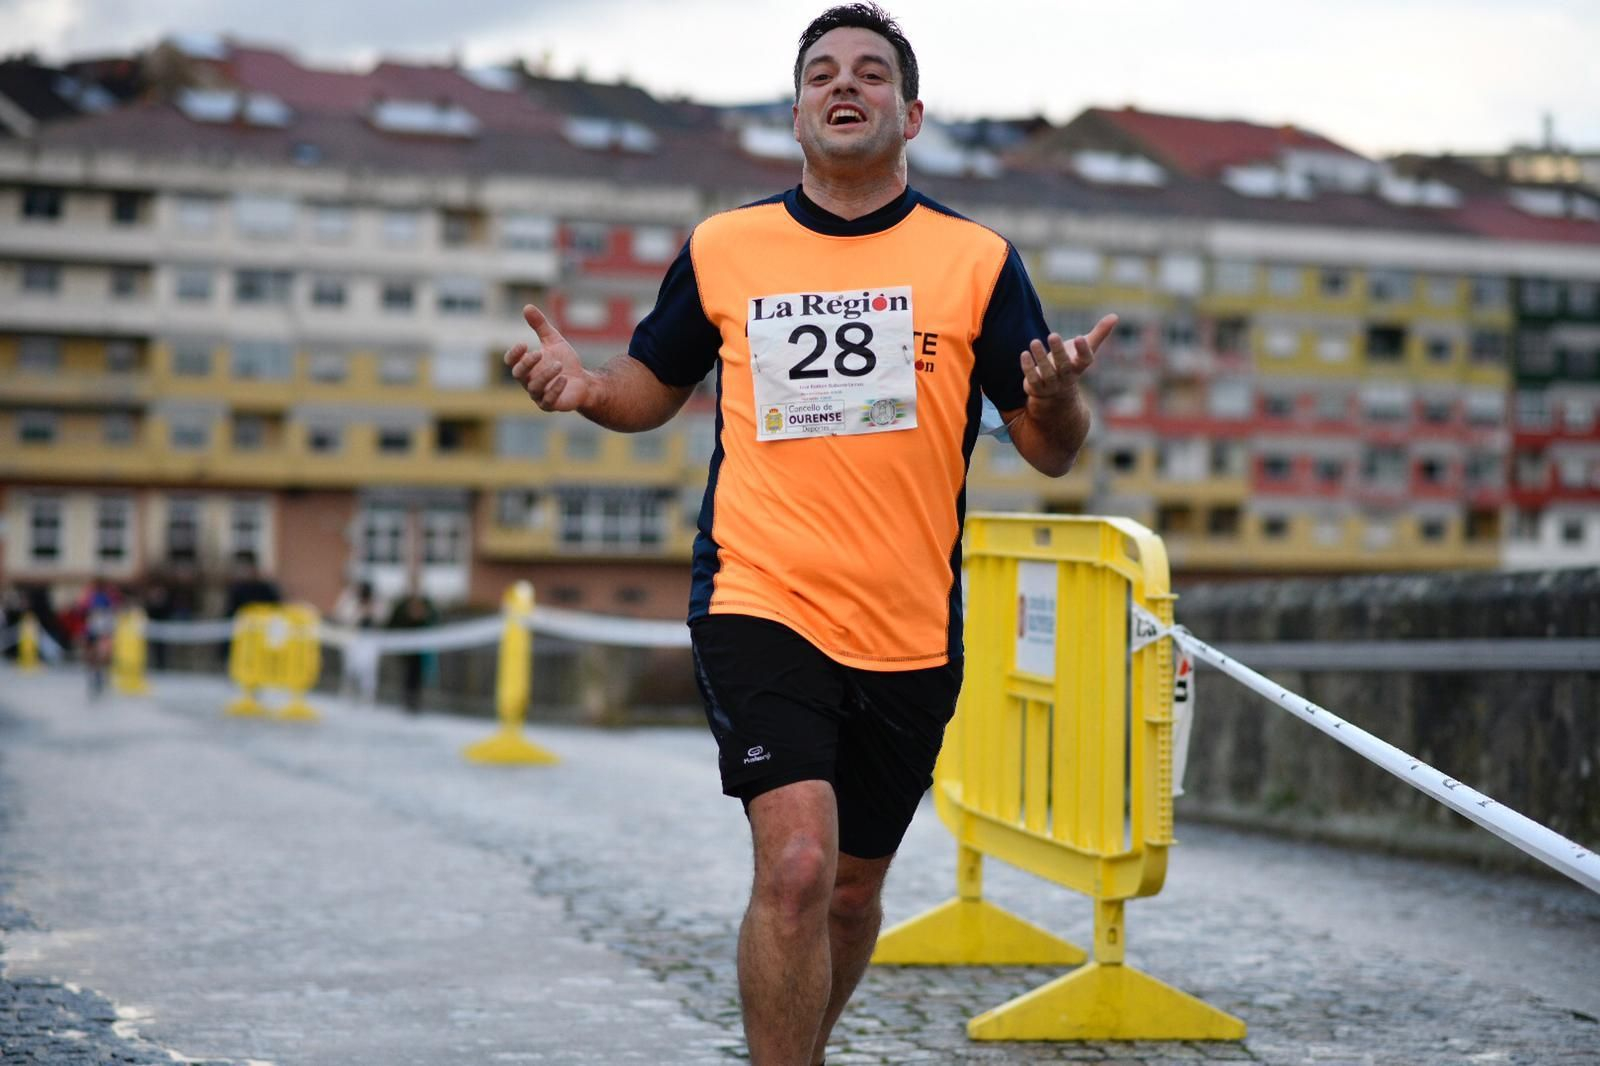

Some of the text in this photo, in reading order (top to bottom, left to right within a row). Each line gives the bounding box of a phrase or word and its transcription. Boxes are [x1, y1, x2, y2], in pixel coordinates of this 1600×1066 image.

[752, 292, 908, 321] La Región
[788, 321, 877, 380] 28
[788, 403, 833, 413] Concello de
[788, 412, 842, 425] OURENSE
